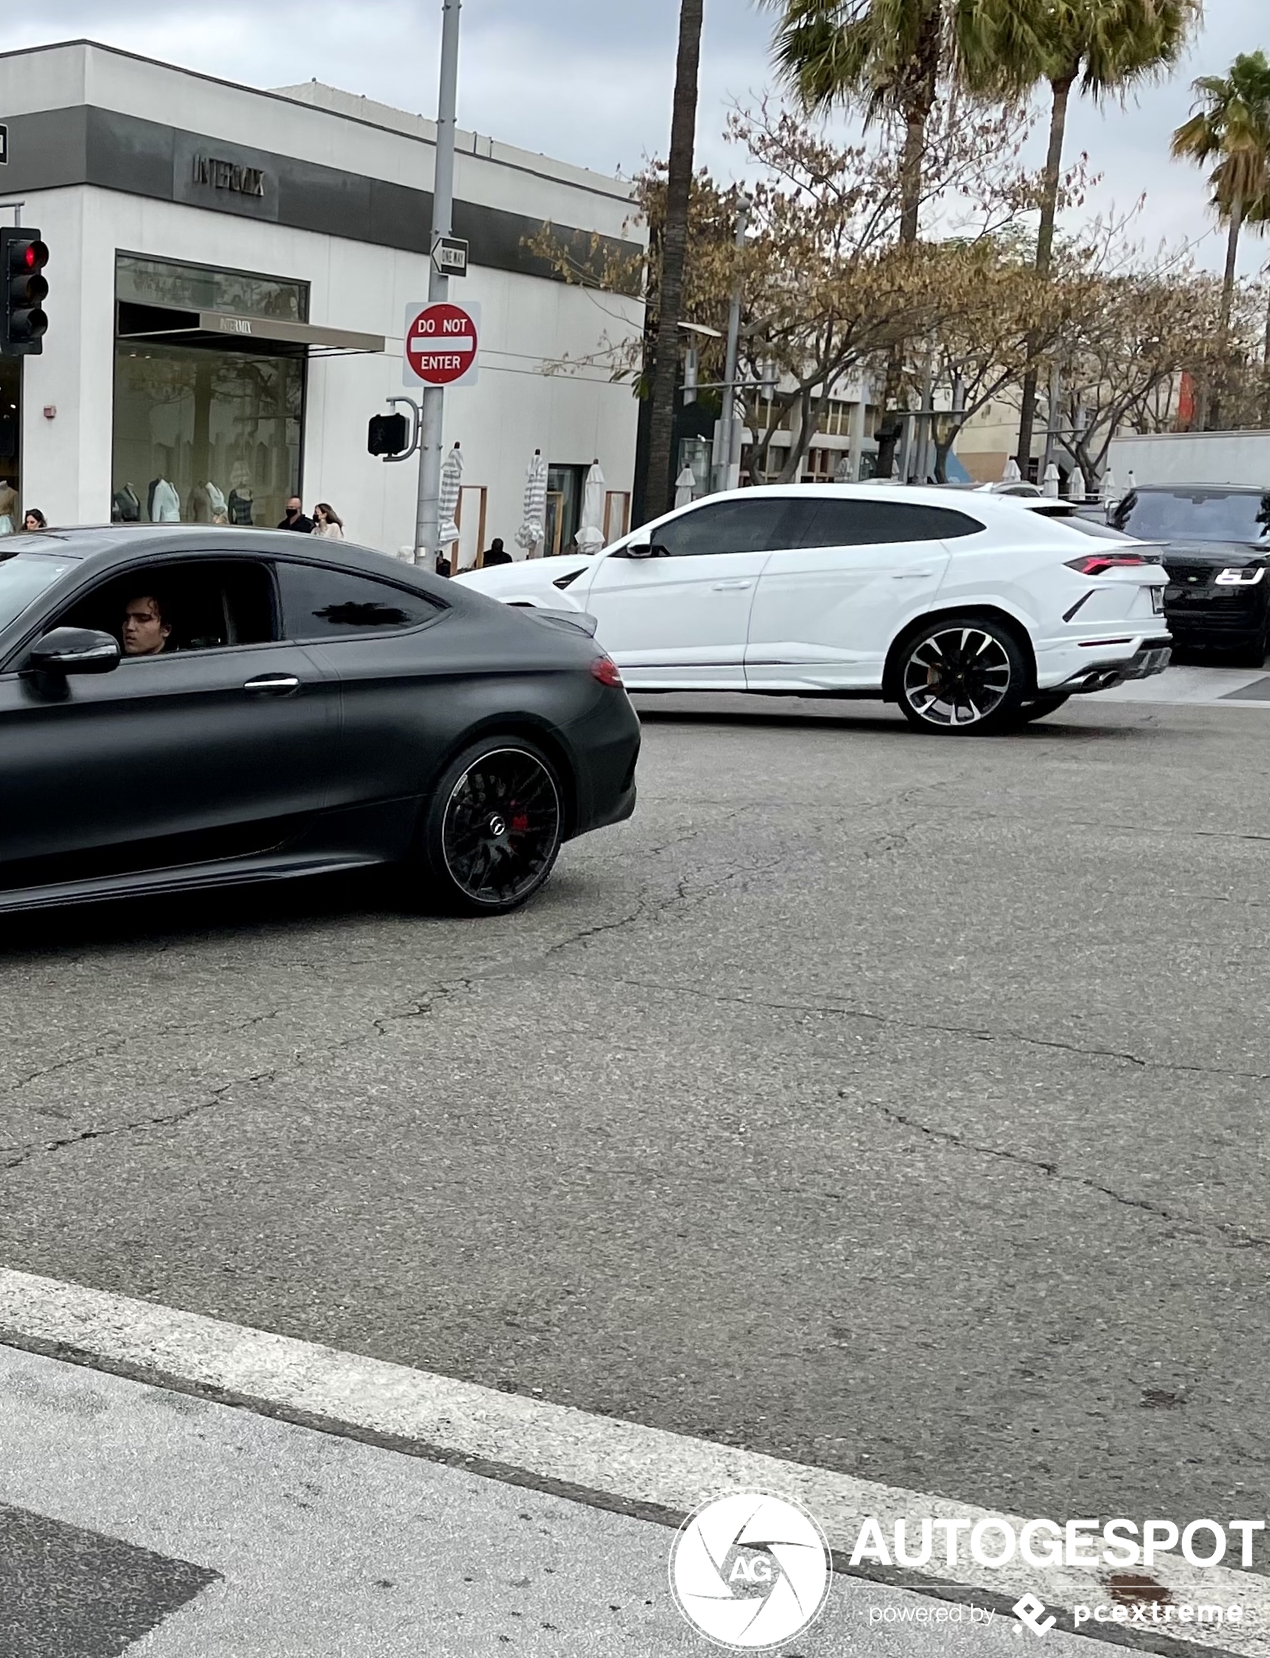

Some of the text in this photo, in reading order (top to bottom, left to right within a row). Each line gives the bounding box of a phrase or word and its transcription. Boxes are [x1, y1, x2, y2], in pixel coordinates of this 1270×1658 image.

[442, 249, 464, 265] ONE WAY
[418, 319, 468, 333] DO NOT
[421, 356, 461, 370] ENTER
